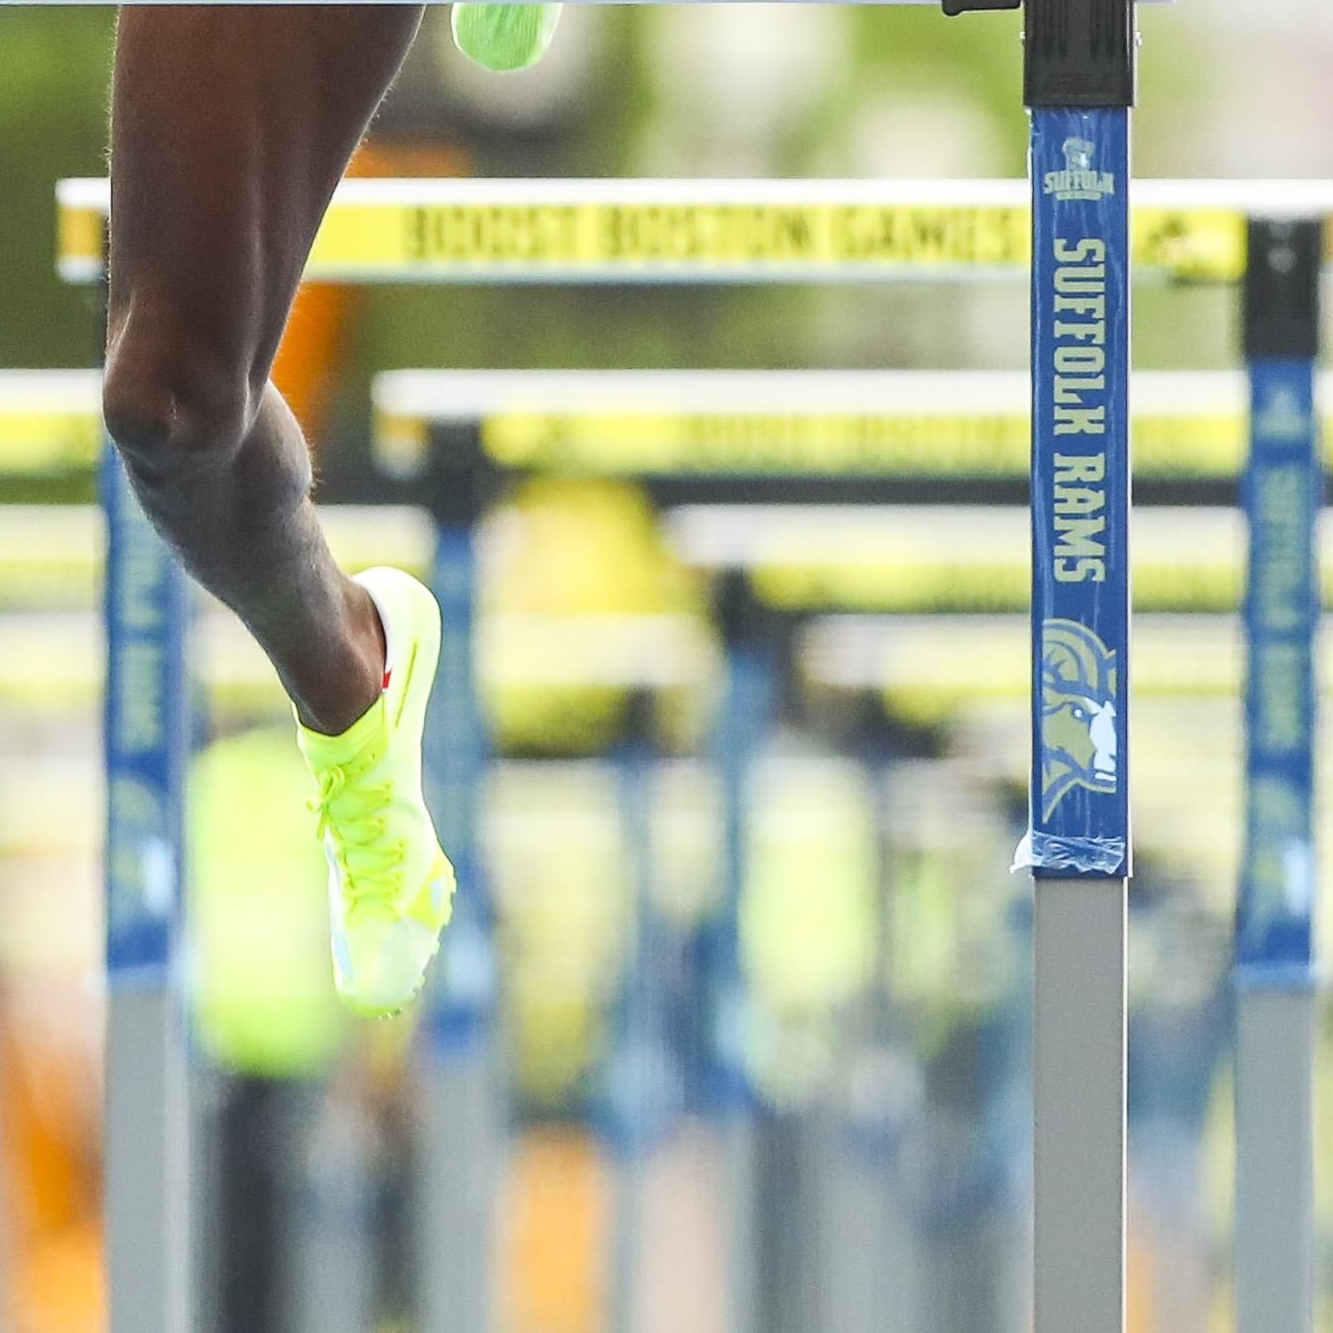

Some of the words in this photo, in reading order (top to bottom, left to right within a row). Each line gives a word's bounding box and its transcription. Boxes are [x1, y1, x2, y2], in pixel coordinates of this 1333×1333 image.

[409, 205, 575, 260] BOOST
[606, 205, 811, 260] BOSTON
[836, 205, 1012, 260] GAMES
[1052, 237, 1107, 436] SUFFOLK
[1052, 453, 1107, 583] RAMS
